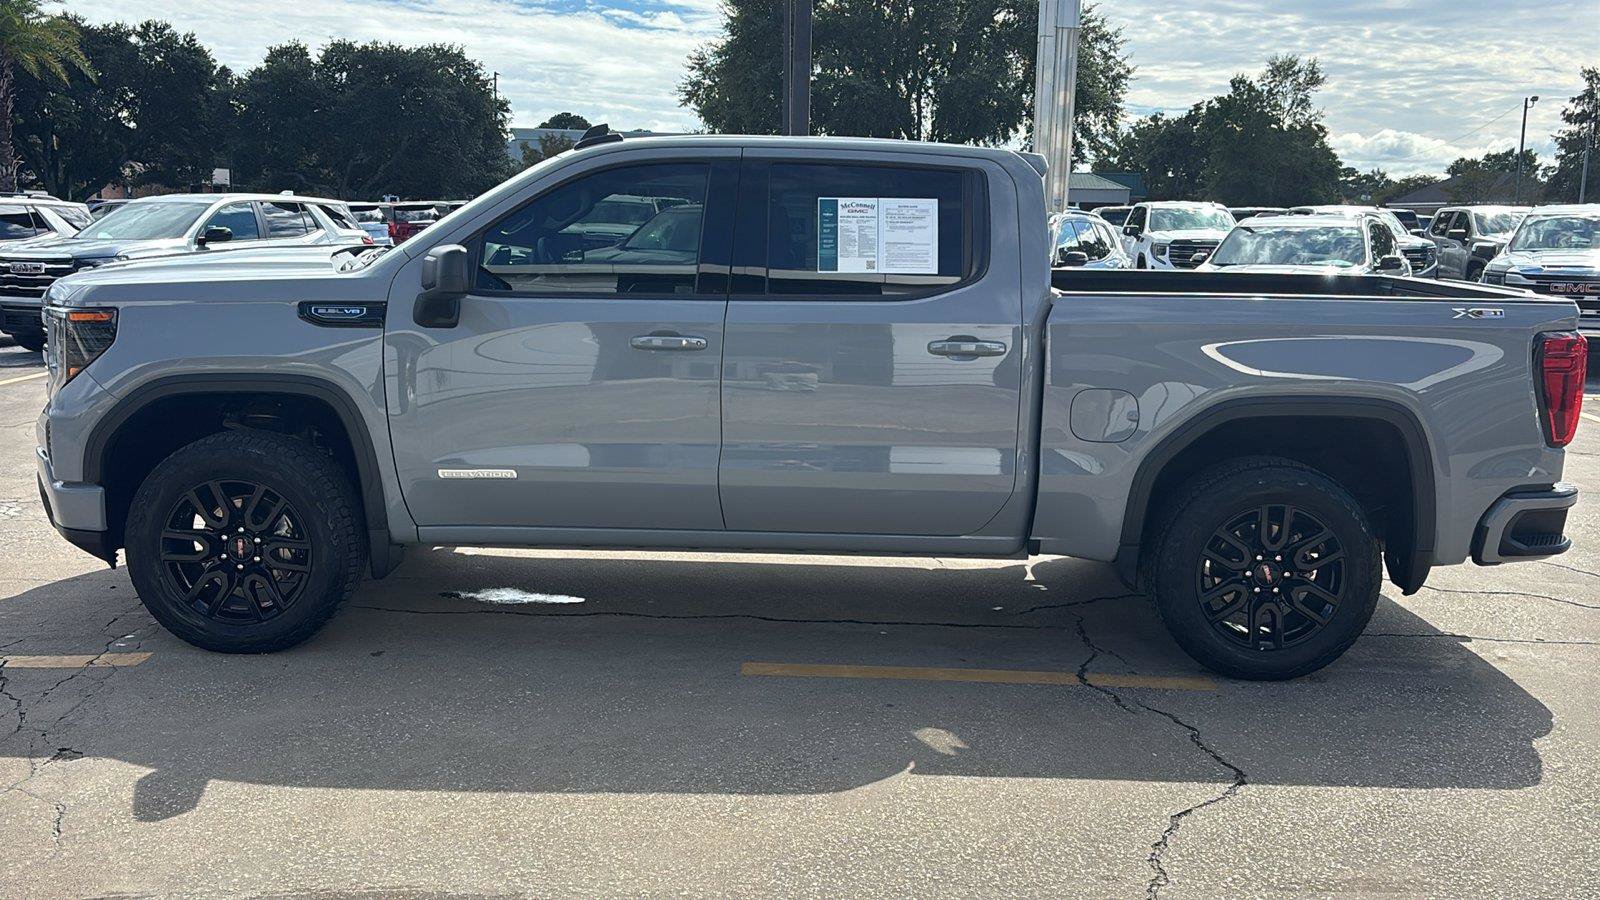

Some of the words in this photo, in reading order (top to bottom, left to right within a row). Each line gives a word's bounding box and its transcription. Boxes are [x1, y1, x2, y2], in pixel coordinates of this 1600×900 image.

[840, 202, 876, 210] McConnell
[1550, 283, 1600, 293] GMC
[440, 470, 514, 479] ELEVATION
